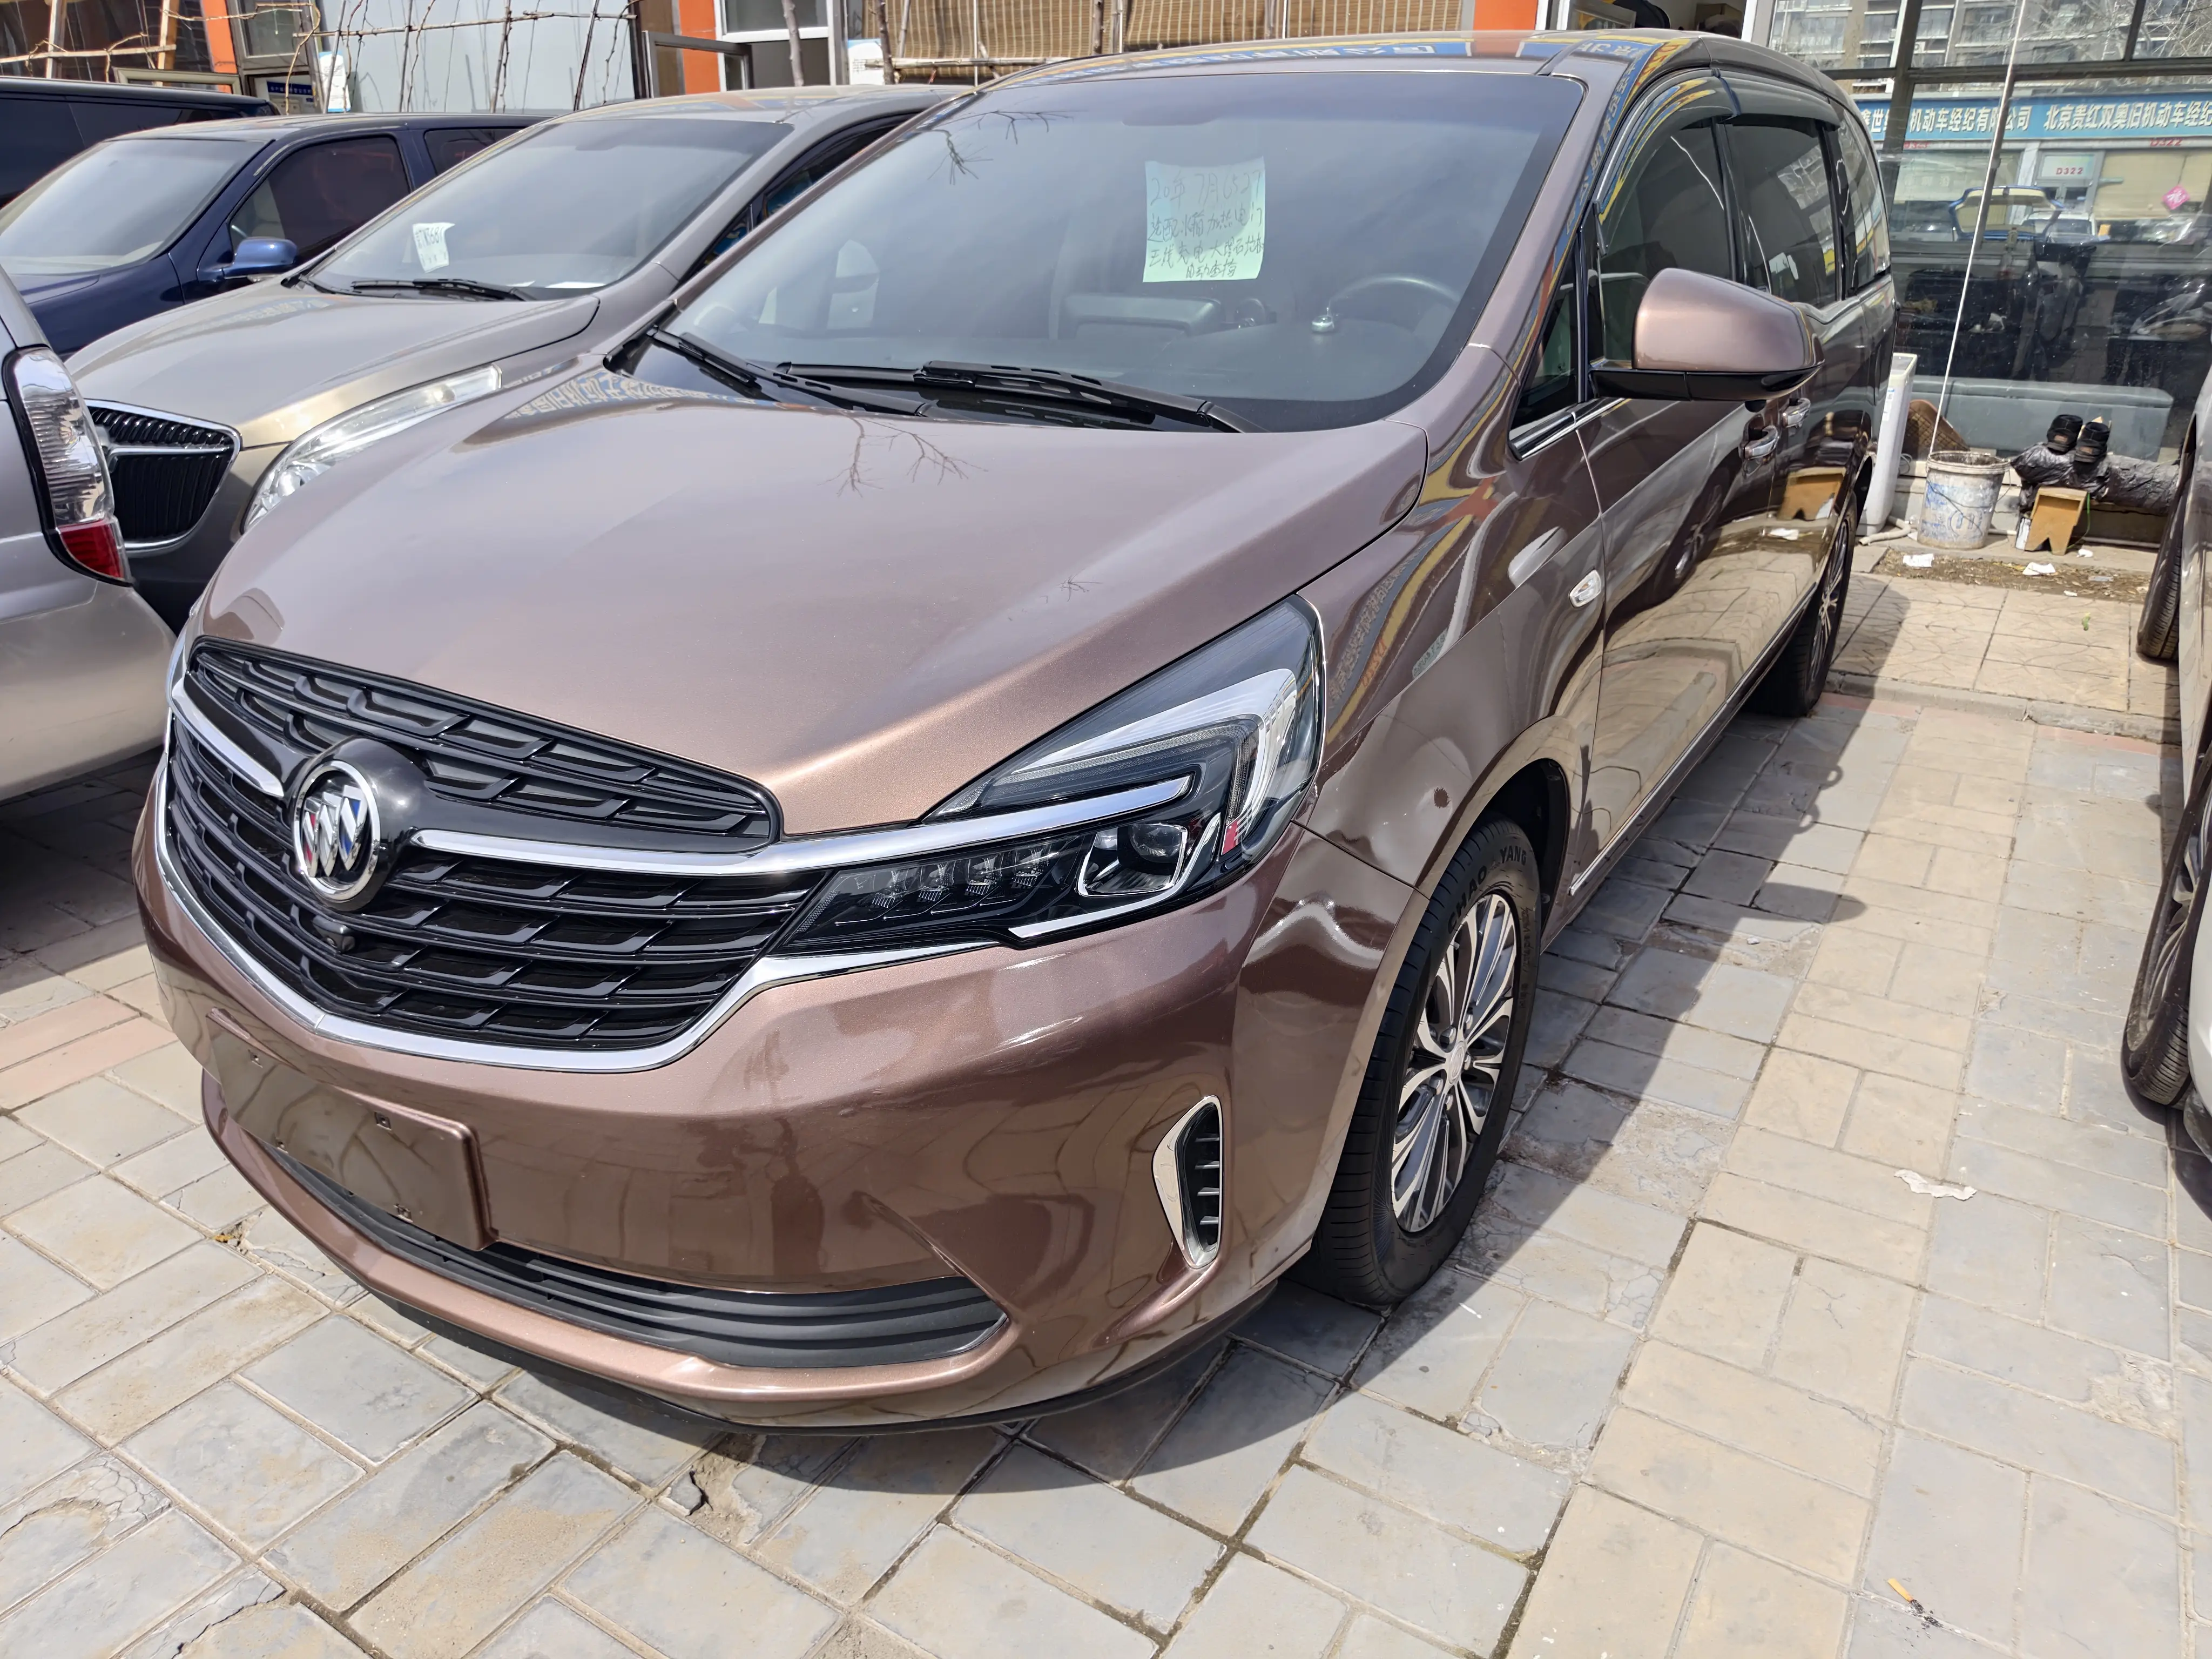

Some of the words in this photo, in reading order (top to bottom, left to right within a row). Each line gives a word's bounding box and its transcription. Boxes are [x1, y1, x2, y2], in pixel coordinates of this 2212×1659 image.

[2056, 167, 2083, 176] D322
[1447, 865, 1487, 934] CHAO
[1500, 845, 1527, 866] YANG
